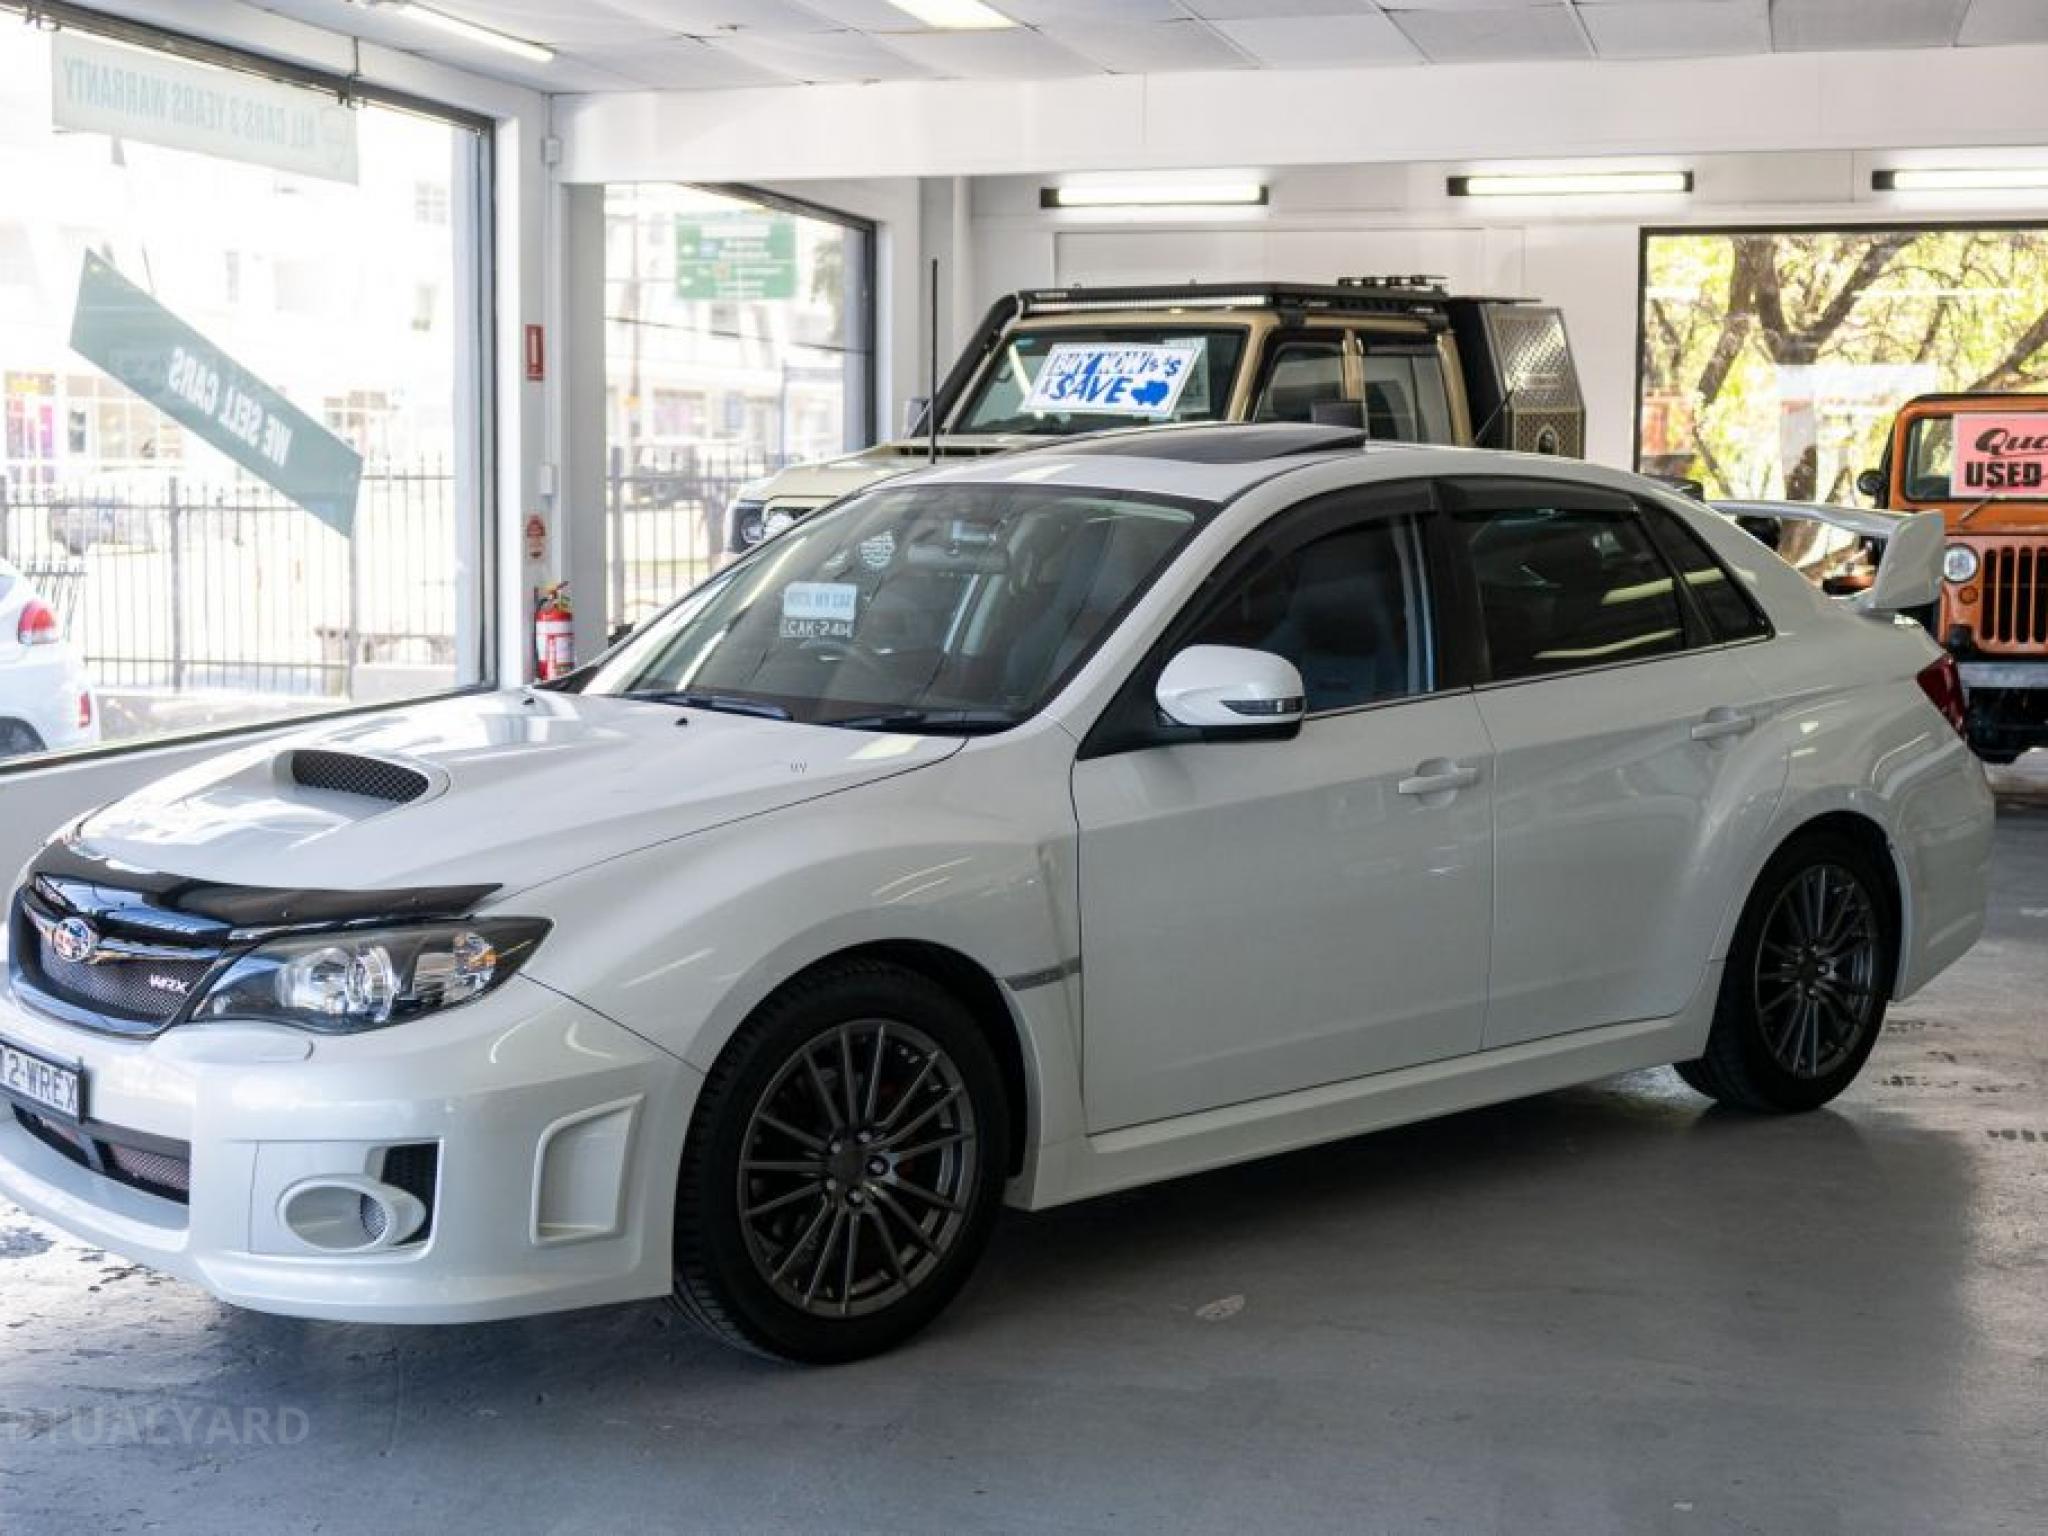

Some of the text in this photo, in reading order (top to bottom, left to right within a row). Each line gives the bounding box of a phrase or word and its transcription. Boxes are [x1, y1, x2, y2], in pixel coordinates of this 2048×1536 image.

[1050, 373, 1133, 403] SAVE
[1965, 461, 2042, 488] USED
[150, 973, 190, 994] WRX
